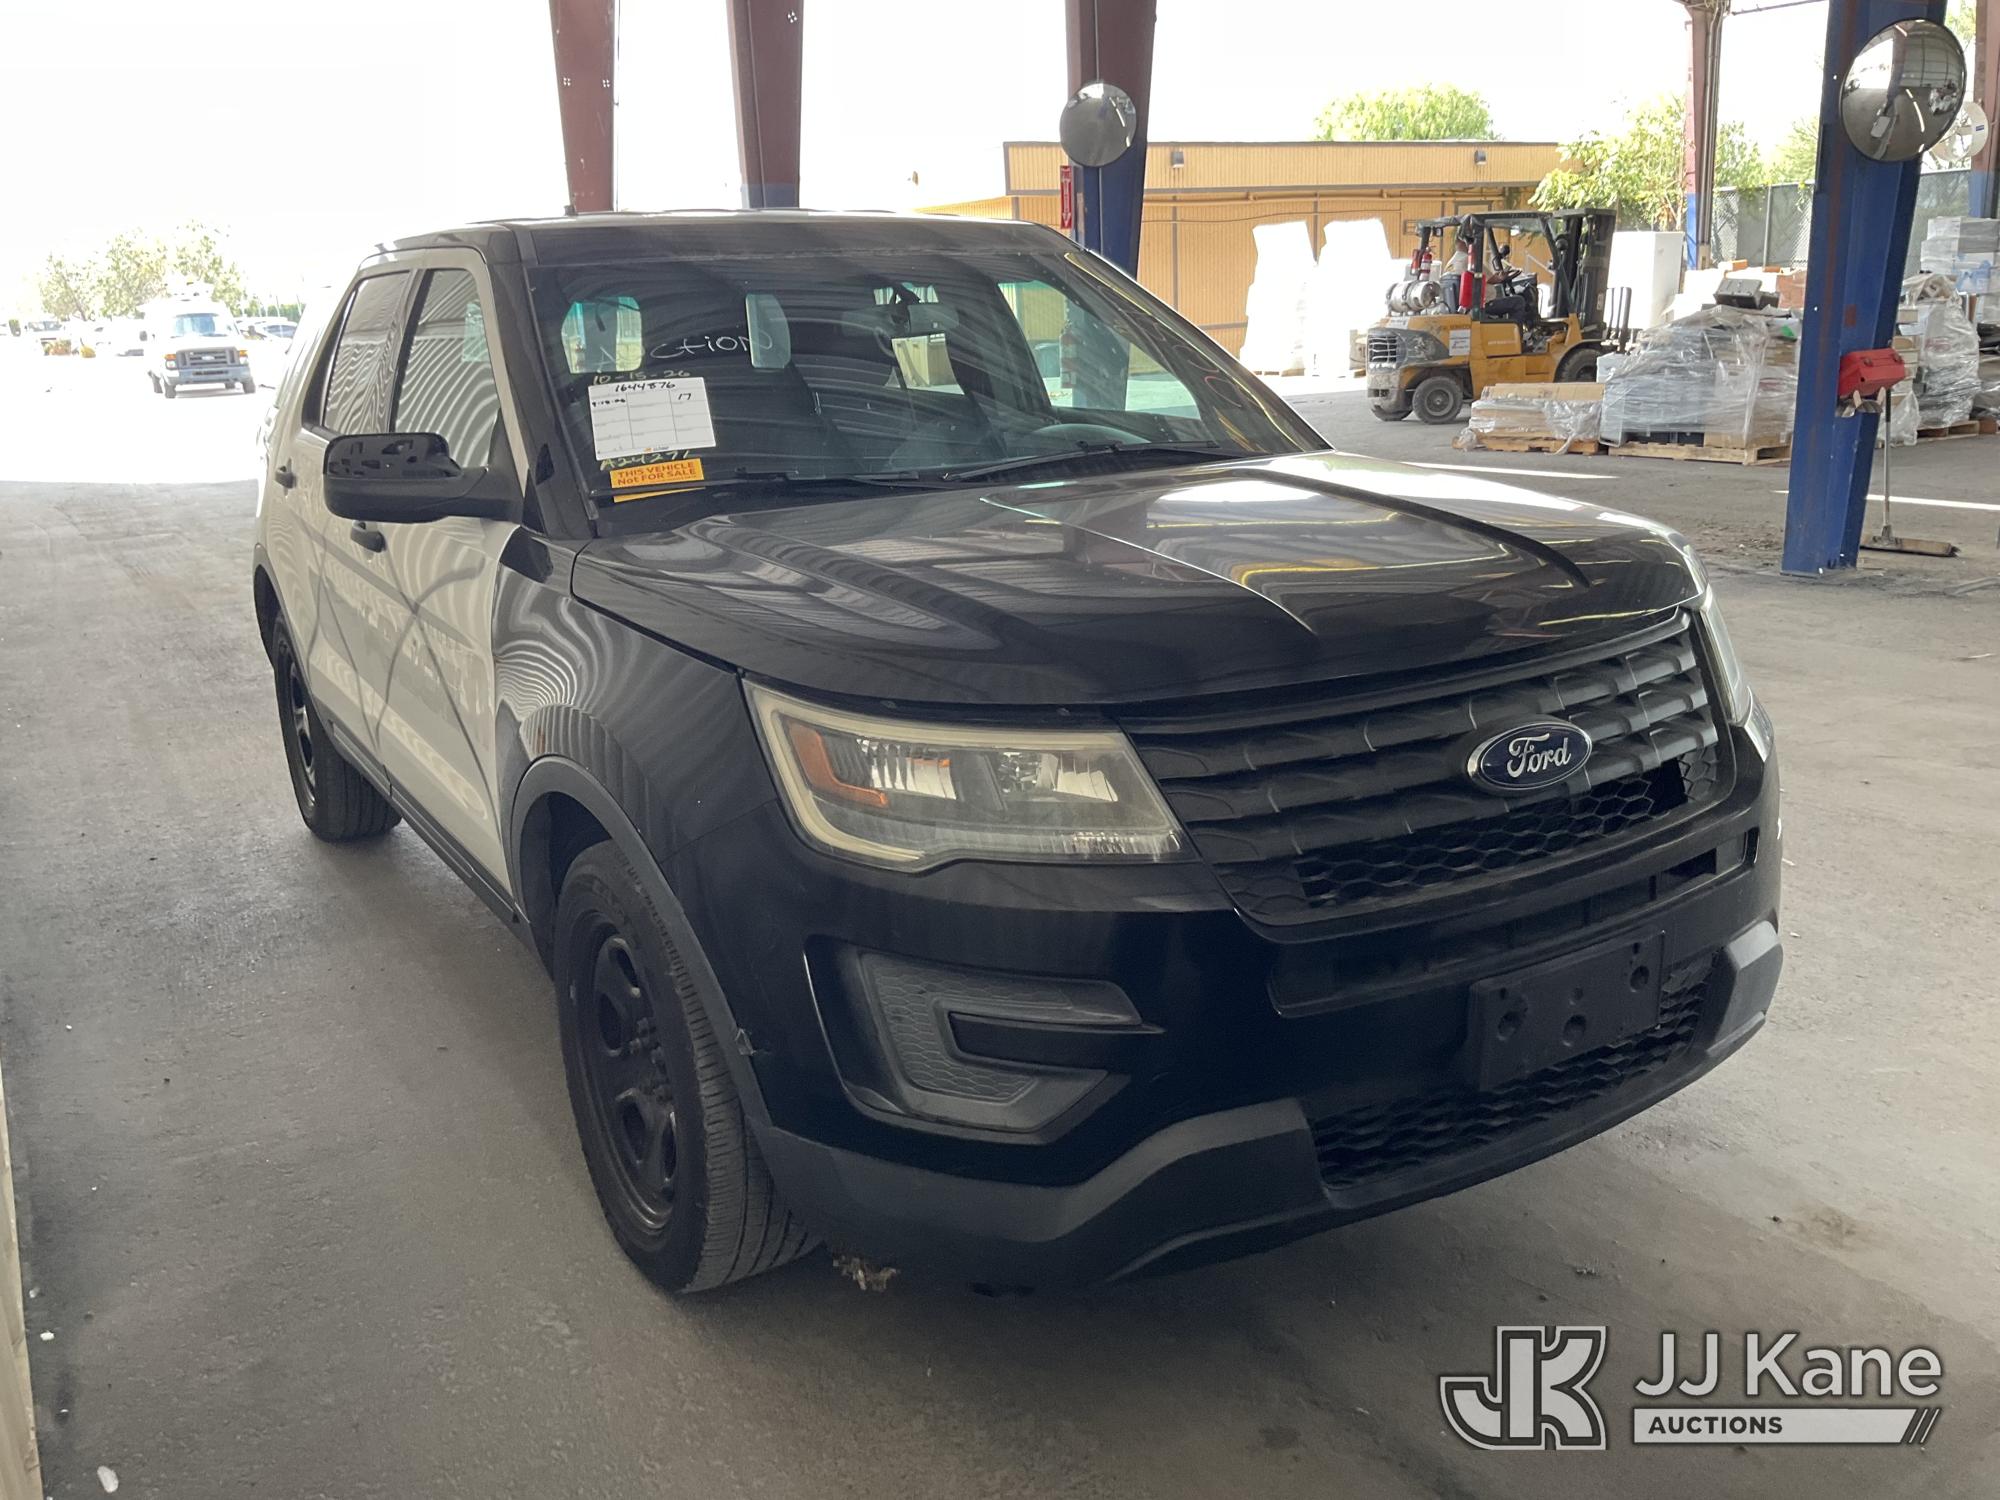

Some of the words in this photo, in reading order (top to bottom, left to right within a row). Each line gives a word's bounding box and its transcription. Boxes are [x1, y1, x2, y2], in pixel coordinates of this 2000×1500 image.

[618, 469, 645, 479] THIS
[645, 462, 694, 474] VEHICLE
[641, 472, 665, 482] FOR
[667, 468, 697, 478] SALE
[1506, 733, 1572, 778] Ford
